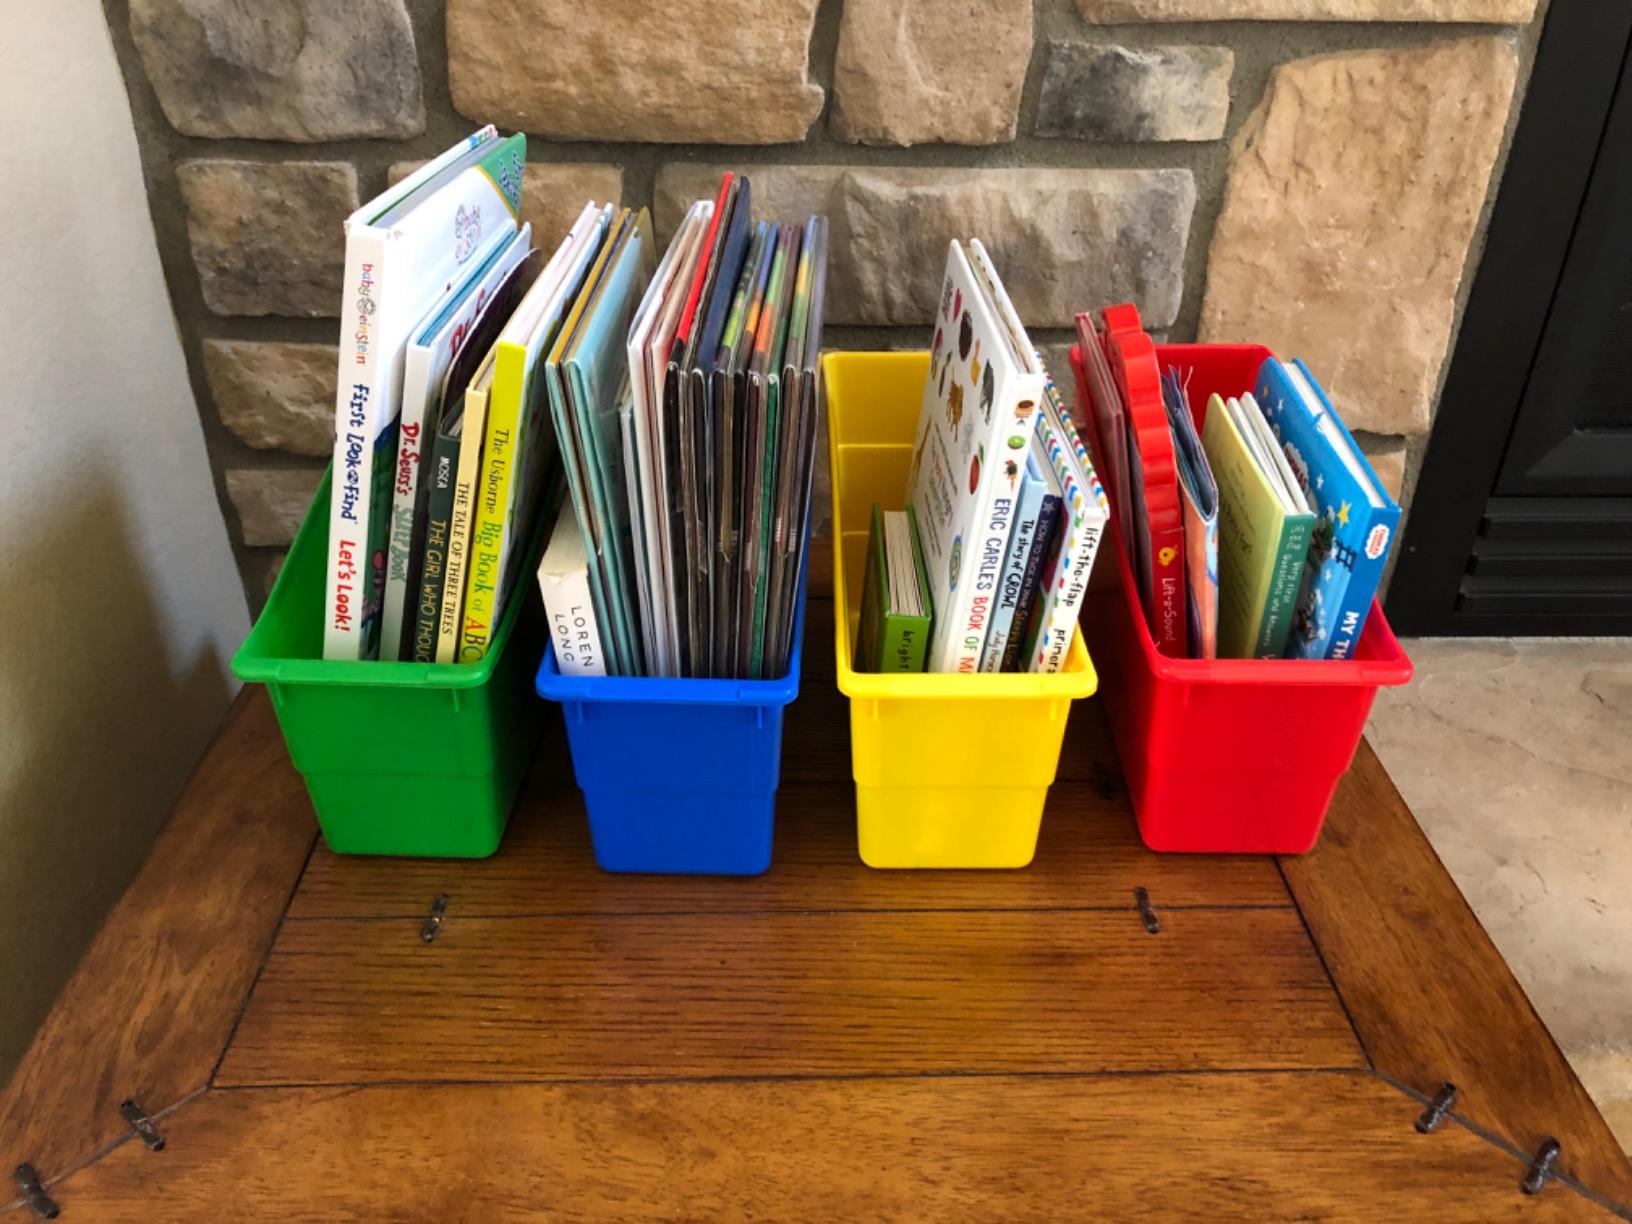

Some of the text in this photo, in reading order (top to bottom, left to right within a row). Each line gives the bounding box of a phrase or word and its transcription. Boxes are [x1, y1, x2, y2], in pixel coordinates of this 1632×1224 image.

[358, 263, 374, 298] baby
[396, 422, 421, 496] Dr. Seuss's
[493, 428, 509, 454] The
[437, 456, 450, 489] MOSCA
[486, 459, 505, 514] Usborne
[989, 498, 1011, 531] ERIC
[1020, 519, 1034, 535] The
[474, 521, 503, 548] Big
[1012, 537, 1029, 559] story
[441, 482, 470, 635] THE TALE OF THREE TREES
[474, 552, 498, 593] Book
[1011, 561, 1023, 571] of
[1062, 527, 1099, 607] lift-the-flap
[335, 540, 356, 631] Let's Look!
[416, 520, 446, 663] THE GIRL WHO THOUG
[967, 596, 989, 631] BOOK
[461, 615, 487, 661] ABC
[571, 606, 595, 667] LOREN
[963, 636, 980, 651] OF
[1331, 611, 1360, 659] MY TH
